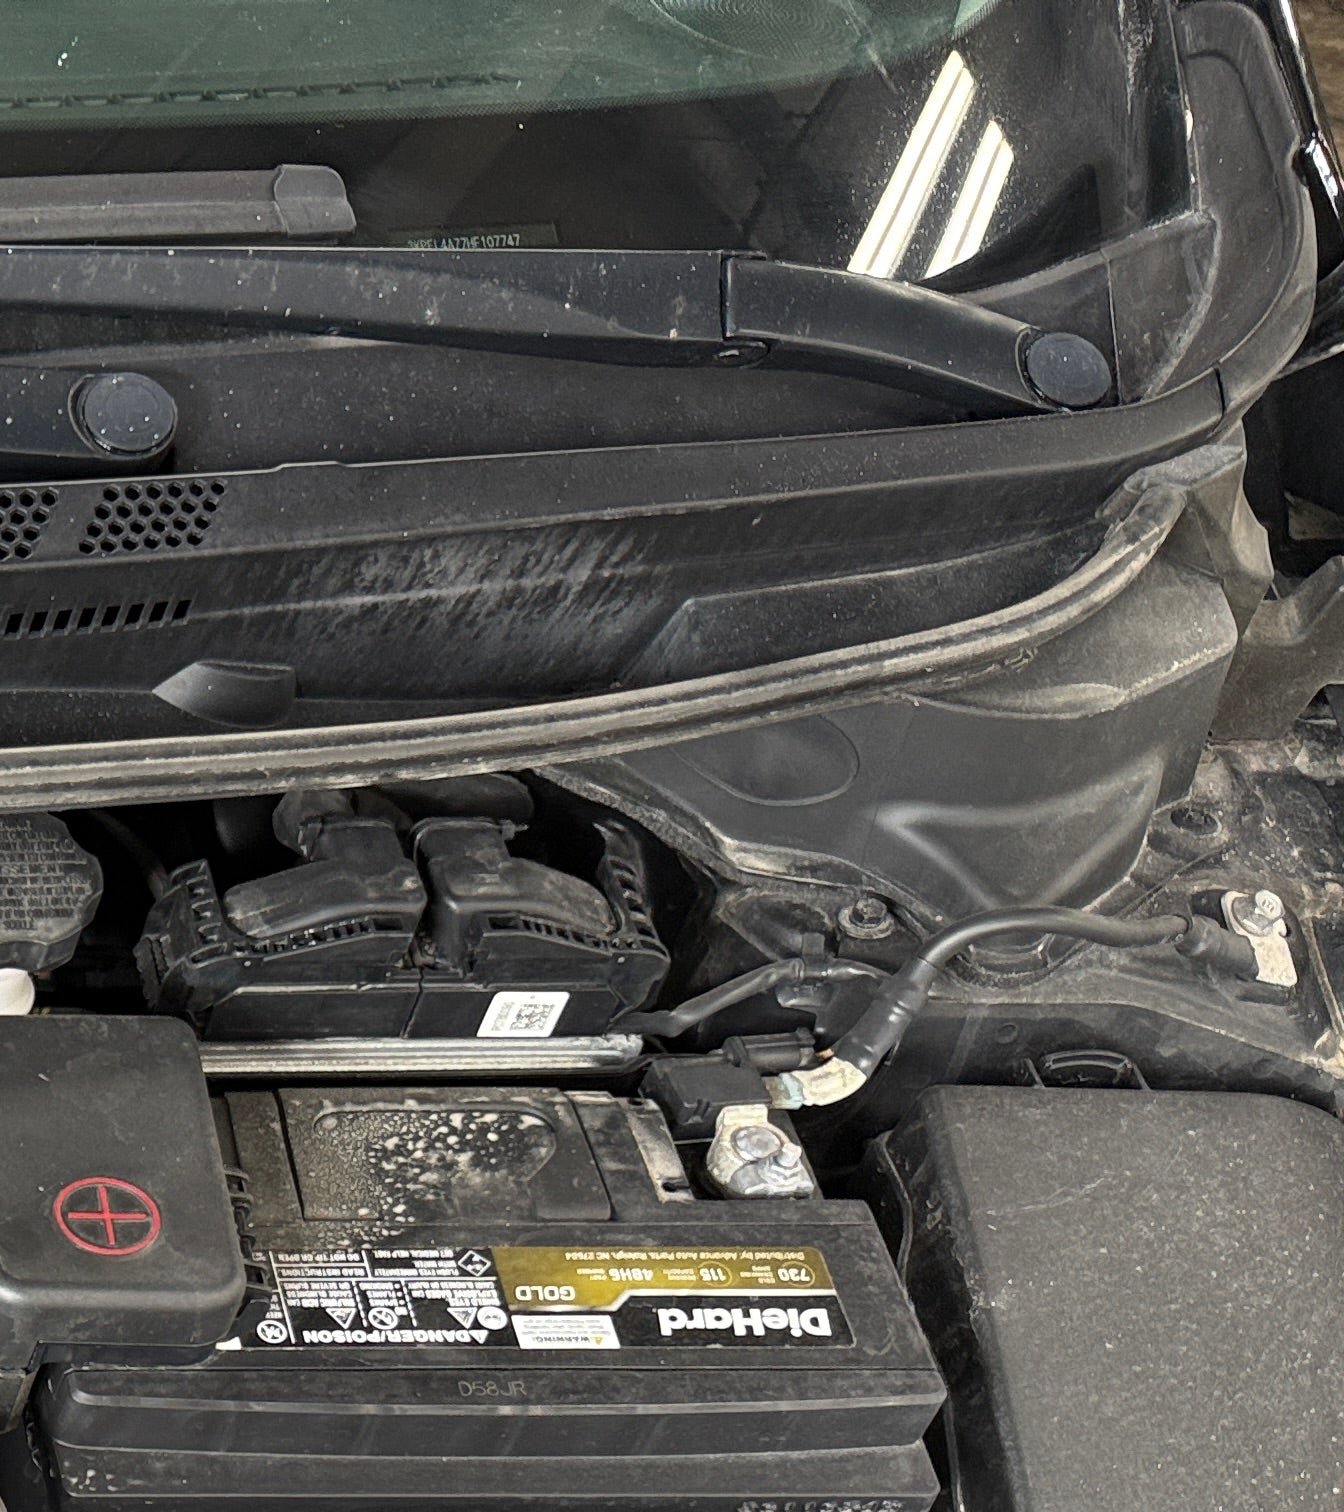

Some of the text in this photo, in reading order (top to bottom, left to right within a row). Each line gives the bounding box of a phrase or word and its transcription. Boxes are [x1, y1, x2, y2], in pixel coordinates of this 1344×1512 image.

[342, 1268, 365, 1276] READ
[608, 1268, 653, 1281] 48H6
[700, 1268, 727, 1281] 115
[778, 1268, 809, 1281] 730
[514, 1285, 576, 1300] GOLD
[657, 1308, 832, 1337] DieHard
[302, 1329, 472, 1343] DANGER/POISON
[457, 1380, 527, 1397] D58JR
